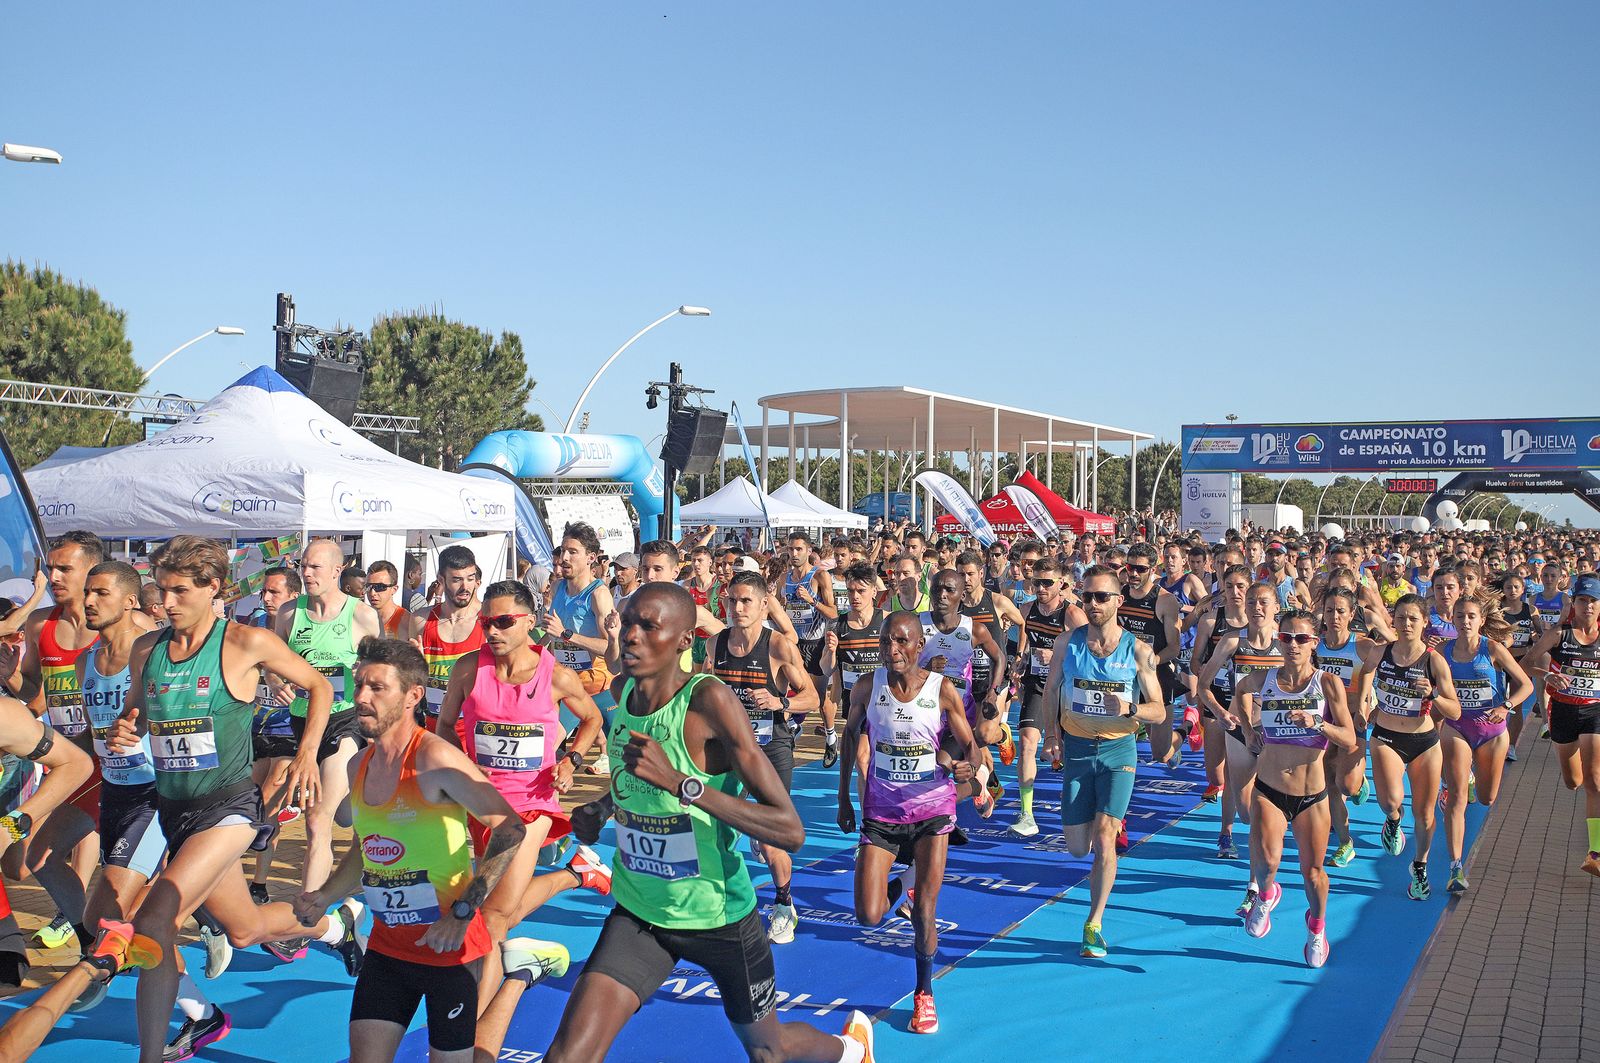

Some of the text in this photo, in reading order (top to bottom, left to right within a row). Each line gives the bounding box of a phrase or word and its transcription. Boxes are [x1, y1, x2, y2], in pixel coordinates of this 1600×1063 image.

[1339, 428, 1447, 440] CAMPEONATO
[1529, 435, 1577, 448] HUELVA
[580, 442, 612, 460] HUELVA
[1338, 440, 1486, 456] de ESPAÑA 10 km
[38, 501, 76, 517] paim
[606, 527, 622, 537] WiHu
[564, 652, 576, 662] 38
[973, 650, 984, 658] 19
[1395, 680, 1409, 688] BM
[1570, 678, 1594, 690] 432
[1392, 686, 1418, 696] RUNNING
[1456, 690, 1480, 700] 426
[1385, 694, 1408, 709] 402
[1083, 705, 1107, 714] Jom
[163, 720, 203, 728] RUNNING
[166, 737, 190, 756] 14
[497, 738, 520, 756] 27
[890, 758, 920, 771] 187
[625, 782, 664, 796] MENORCA
[631, 814, 678, 825] RUNNING
[642, 826, 670, 834] LOOP
[626, 832, 668, 859] 107
[382, 890, 409, 909] 22
